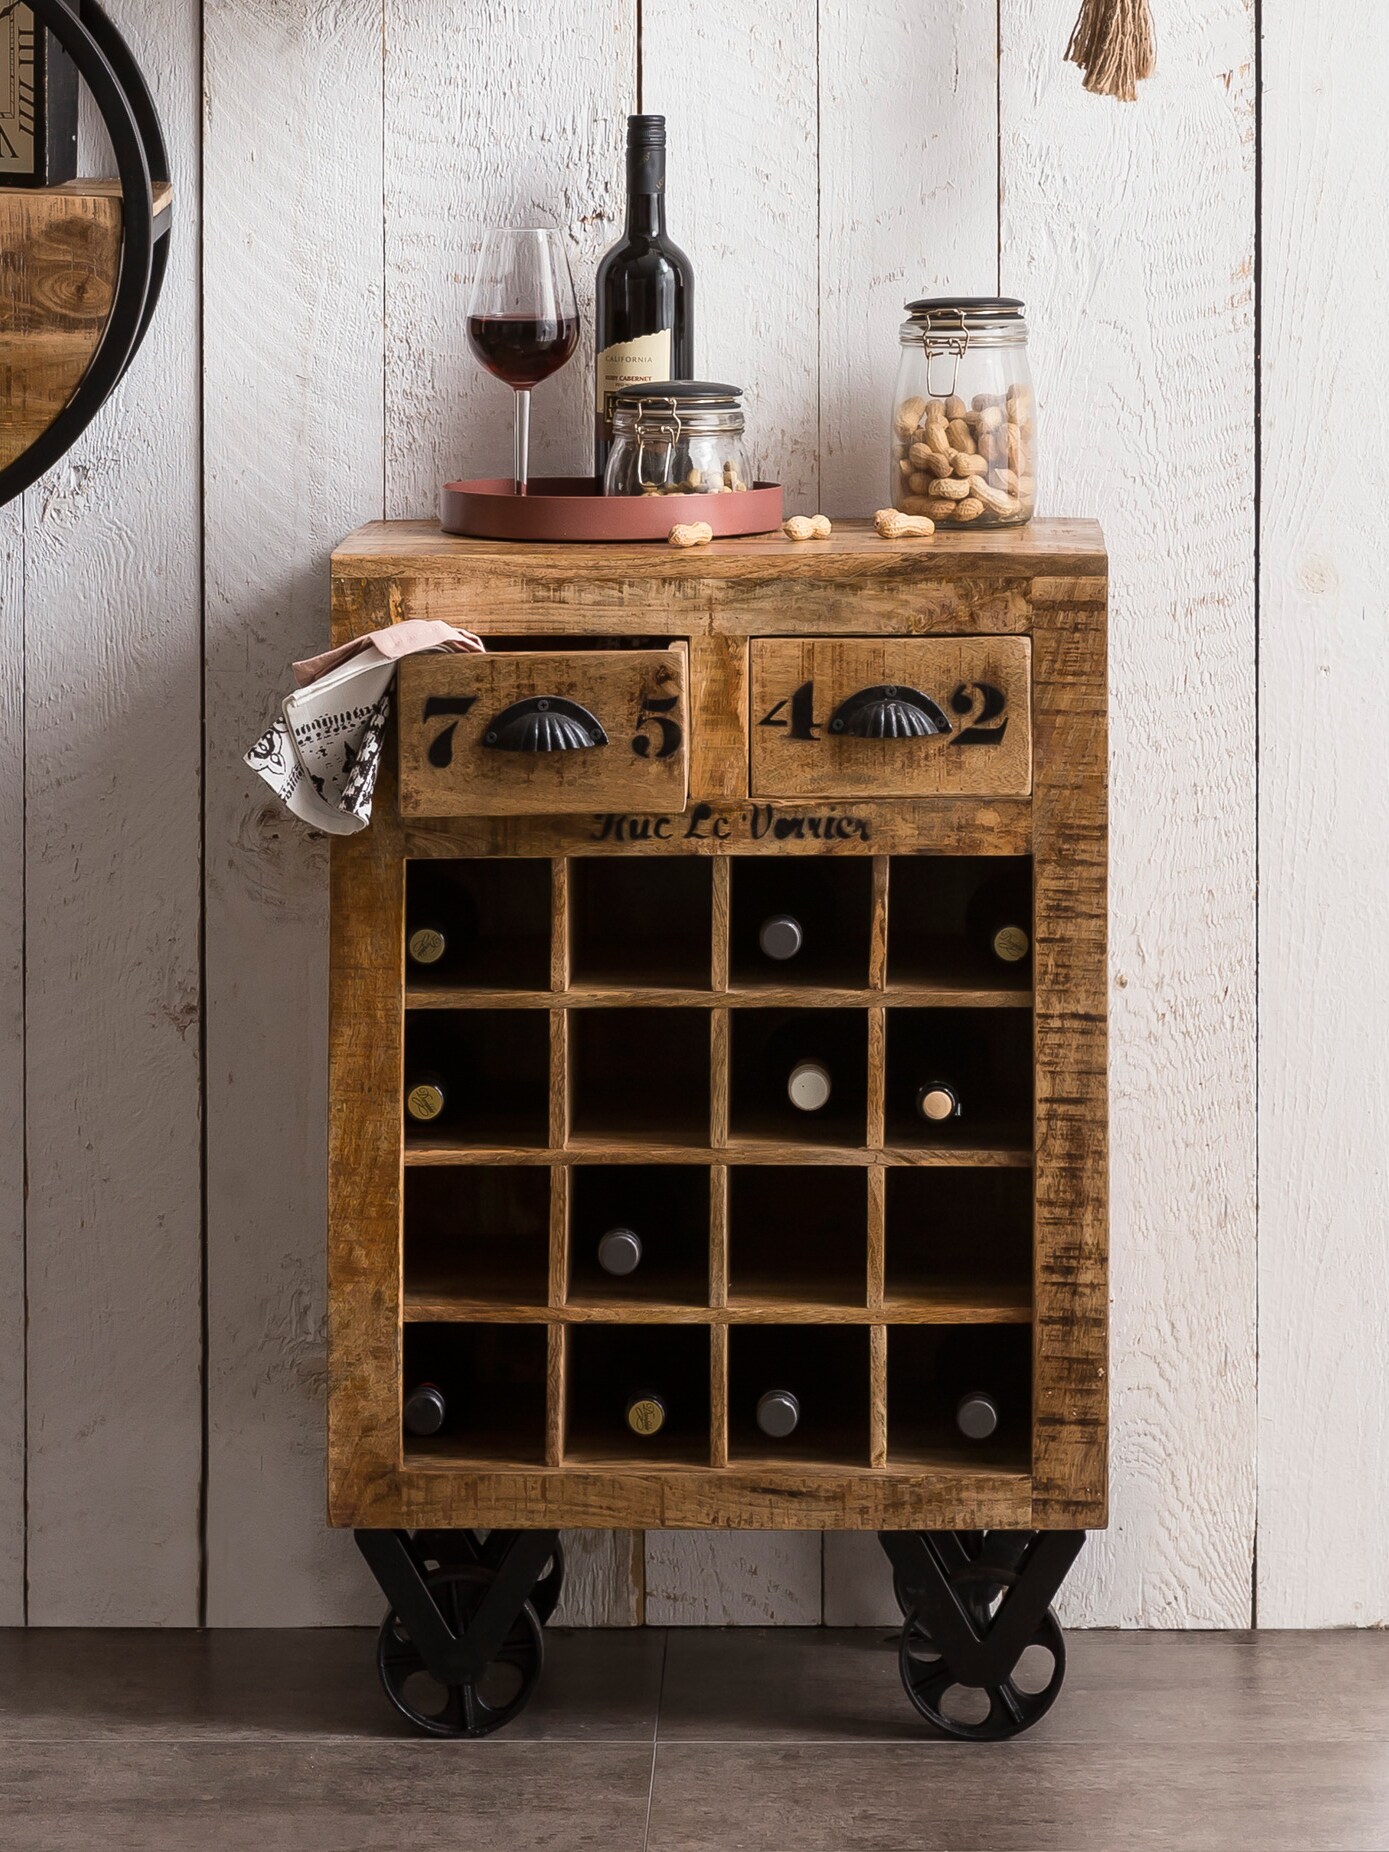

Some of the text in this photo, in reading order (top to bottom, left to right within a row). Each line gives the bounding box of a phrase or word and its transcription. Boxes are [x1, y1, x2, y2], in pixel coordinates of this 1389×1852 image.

[605, 355, 653, 363] CALIFORNIA
[422, 695, 479, 768] 7
[631, 694, 682, 758] 5
[758, 680, 822, 742] 4
[951, 682, 1009, 746] 2
[683, 803, 732, 841] Le
